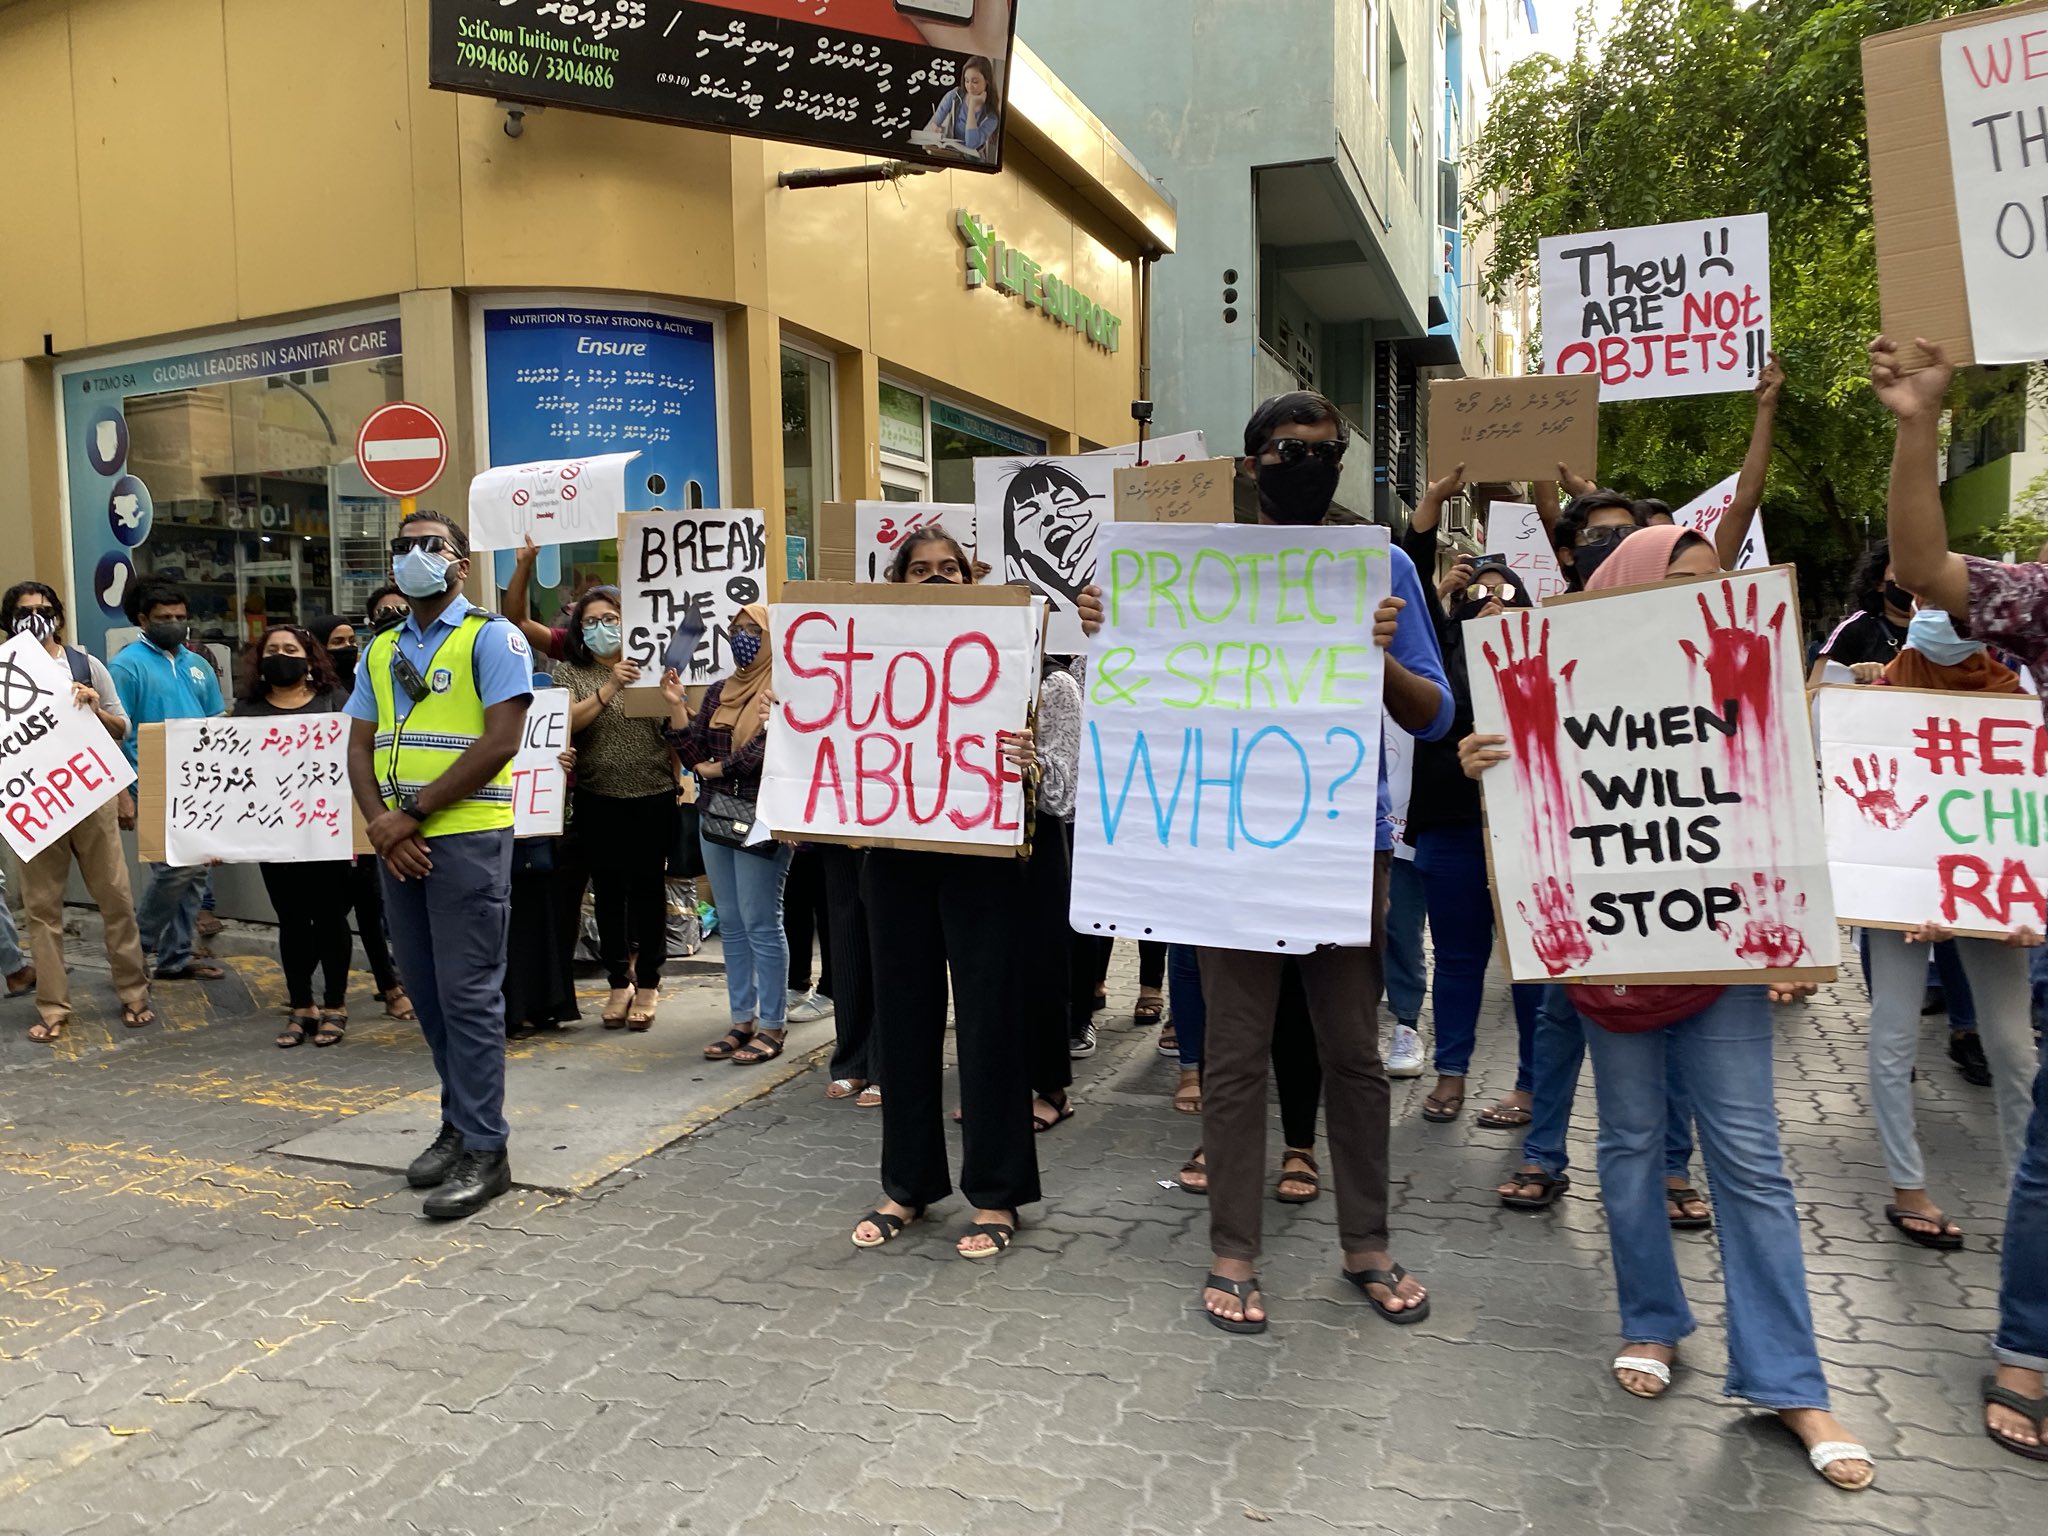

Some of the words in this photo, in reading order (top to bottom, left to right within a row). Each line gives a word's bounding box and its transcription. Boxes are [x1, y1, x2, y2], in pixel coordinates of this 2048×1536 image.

[456, 41, 530, 76] 7994686
[531, 53, 542, 79] /
[545, 56, 615, 90] 3304686
[458, 15, 513, 45] SciCom
[517, 25, 569, 54] Tuition
[572, 36, 620, 62] Centre
[1560, 241, 1686, 297] They
[994, 240, 1043, 309] LIFE
[1041, 272, 1122, 353] SUPPORT
[1581, 294, 1664, 338] ARE
[510, 313, 565, 325] NUTRITION
[567, 313, 582, 324] TO
[584, 314, 609, 325] STAY
[611, 316, 654, 329] STRONG
[655, 319, 663, 330] &
[664, 321, 694, 336] ACTIVE
[576, 336, 647, 357] Ensure
[152, 361, 201, 384] GLOBAL
[203, 355, 259, 376] LEADERS
[261, 349, 276, 367] IN
[279, 337, 346, 365] SANITARY
[348, 330, 387, 352] CARE
[637, 516, 766, 582] BREAK
[1110, 547, 1390, 630] PROTECT
[1090, 646, 1150, 705] &
[1161, 641, 1371, 710] SERVE
[1563, 698, 1739, 751] WHEN
[5, 746, 115, 844] RAPE!
[803, 729, 1023, 831] ABUSE
[1088, 719, 1366, 852] WHO?
[1581, 766, 1743, 811] WILL
[1569, 814, 1722, 868] THIS
[1587, 886, 1742, 938] STOP
